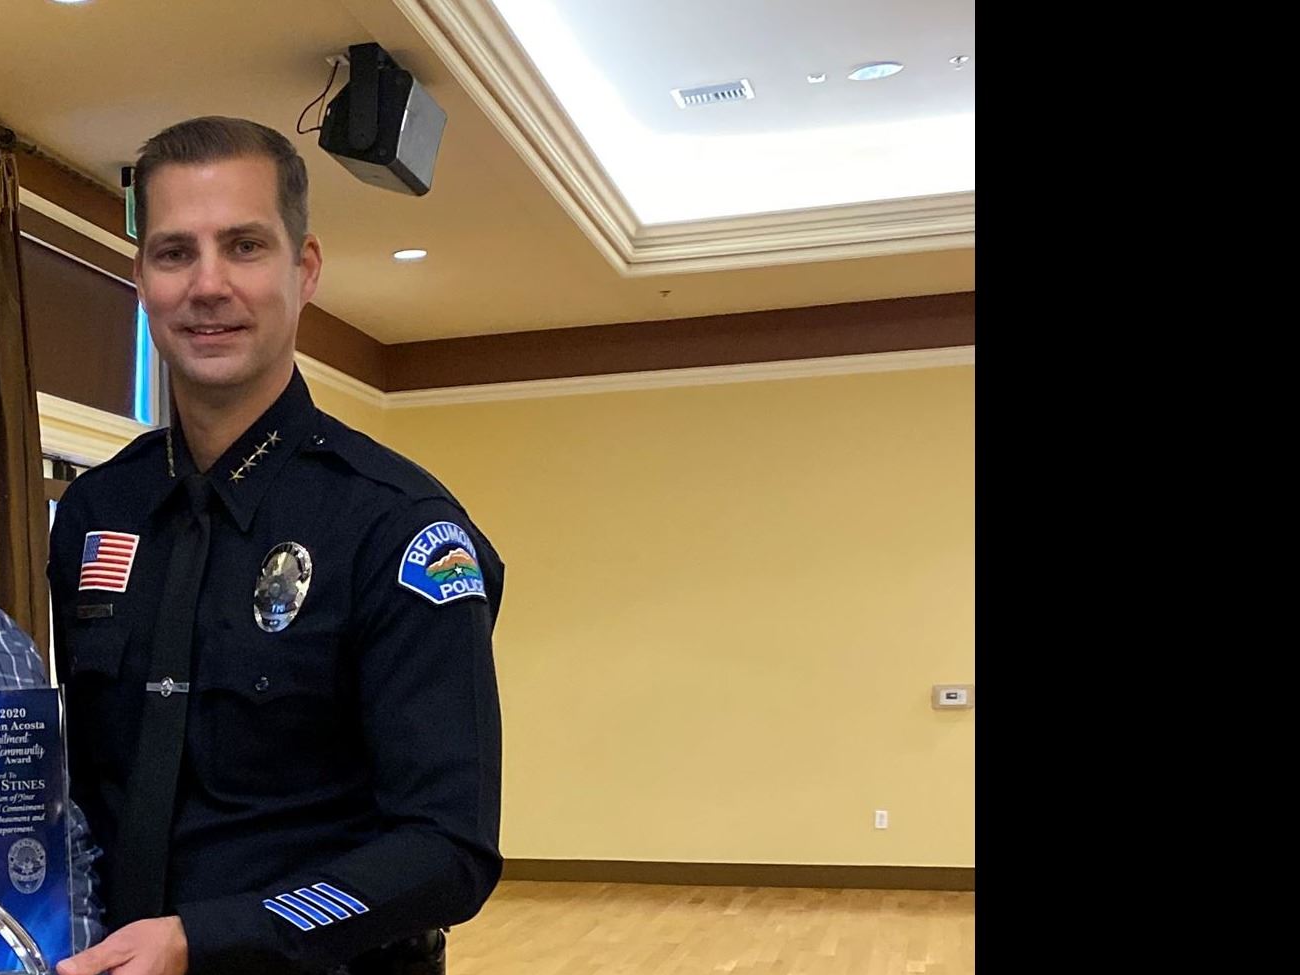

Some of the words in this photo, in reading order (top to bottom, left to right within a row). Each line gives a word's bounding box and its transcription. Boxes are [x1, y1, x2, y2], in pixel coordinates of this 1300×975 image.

[0, 708, 26, 719] 2020
[11, 721, 45, 731] Acosta
[4, 756, 31, 765] Award
[10, 793, 18, 803] of
[32, 813, 46, 821] and
